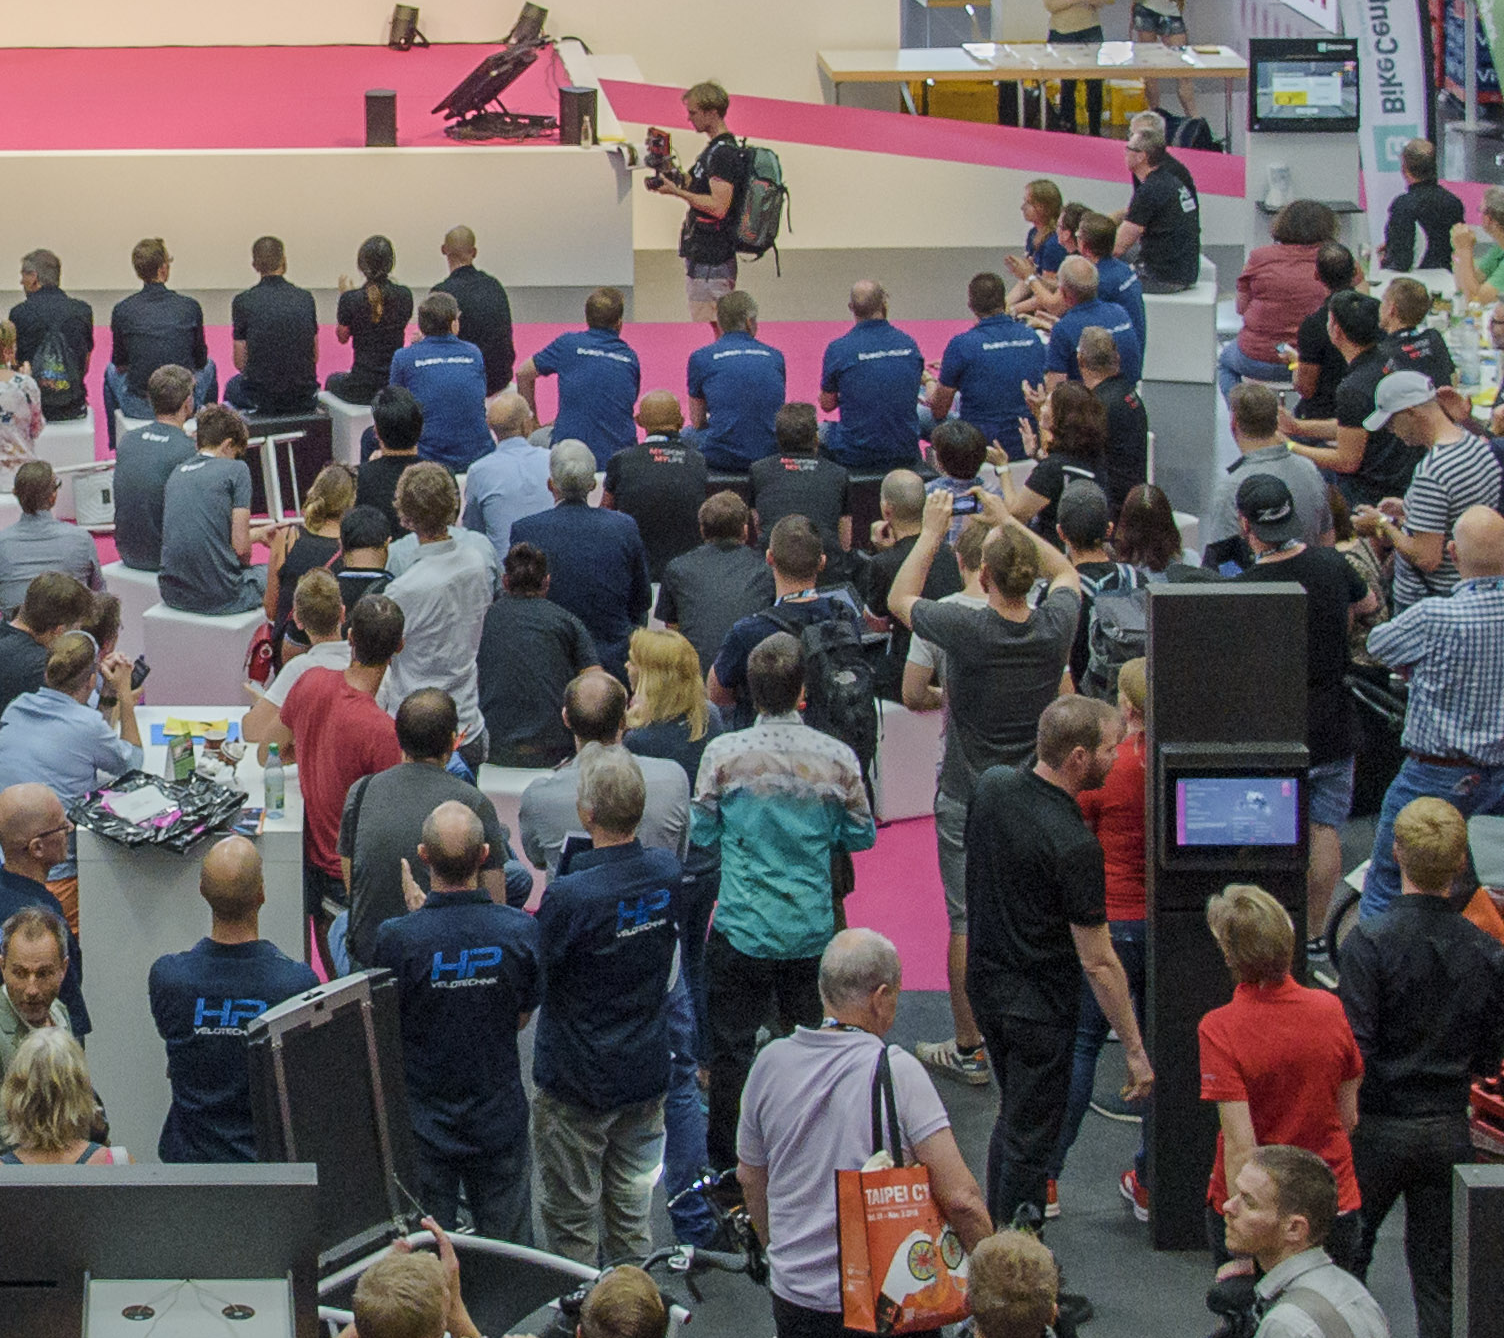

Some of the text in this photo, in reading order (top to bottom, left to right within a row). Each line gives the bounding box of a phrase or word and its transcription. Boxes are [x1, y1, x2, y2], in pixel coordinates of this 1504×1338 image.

[616, 888, 671, 931] HP
[431, 946, 503, 981] HP
[430, 975, 499, 989] VELOTECHNIK
[194, 997, 268, 1027] HP
[865, 1185, 909, 1206] TAIPEI
